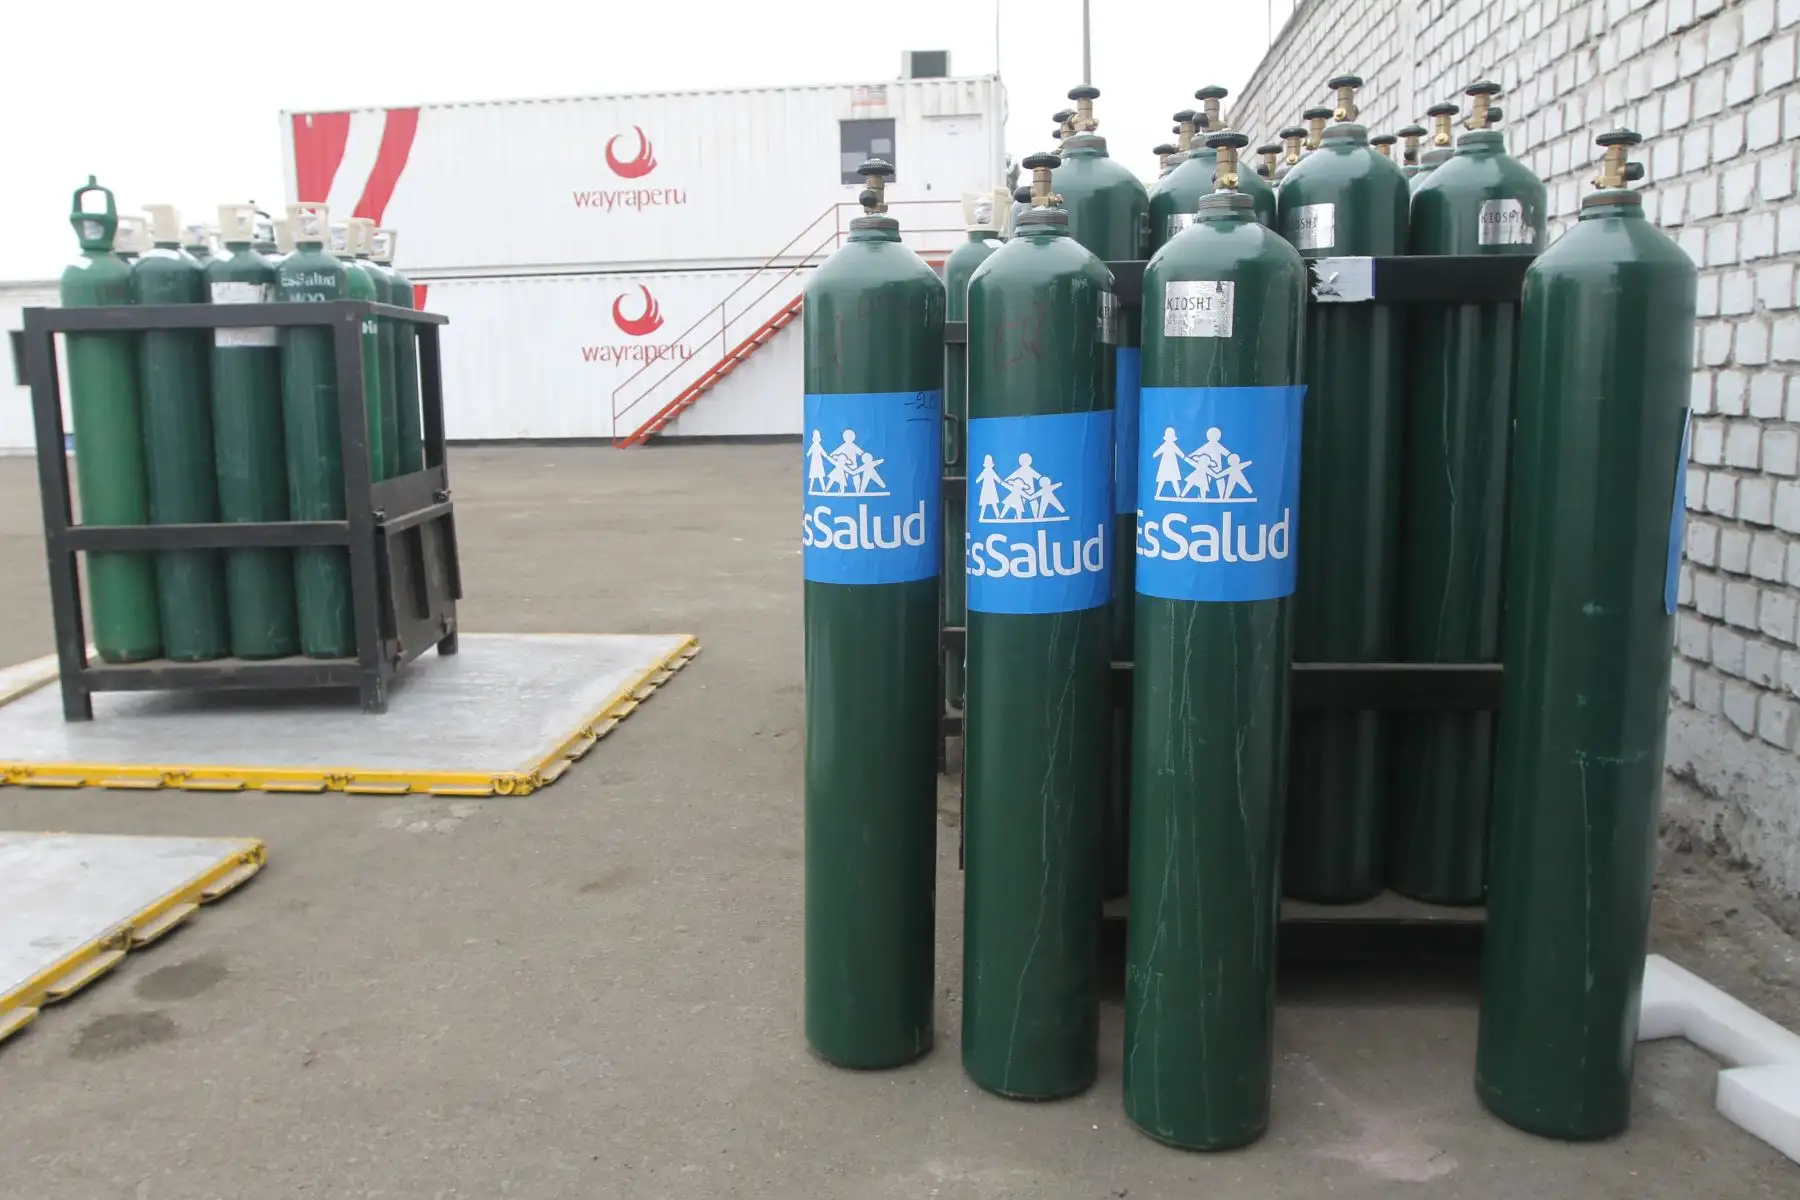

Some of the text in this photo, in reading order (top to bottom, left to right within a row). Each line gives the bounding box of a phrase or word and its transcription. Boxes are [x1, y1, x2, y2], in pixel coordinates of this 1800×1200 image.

[573, 187, 687, 213] wayraperu
[1166, 296, 1213, 311] KIOSHI
[581, 343, 695, 368] wayraperu
[802, 500, 925, 550] sSalud
